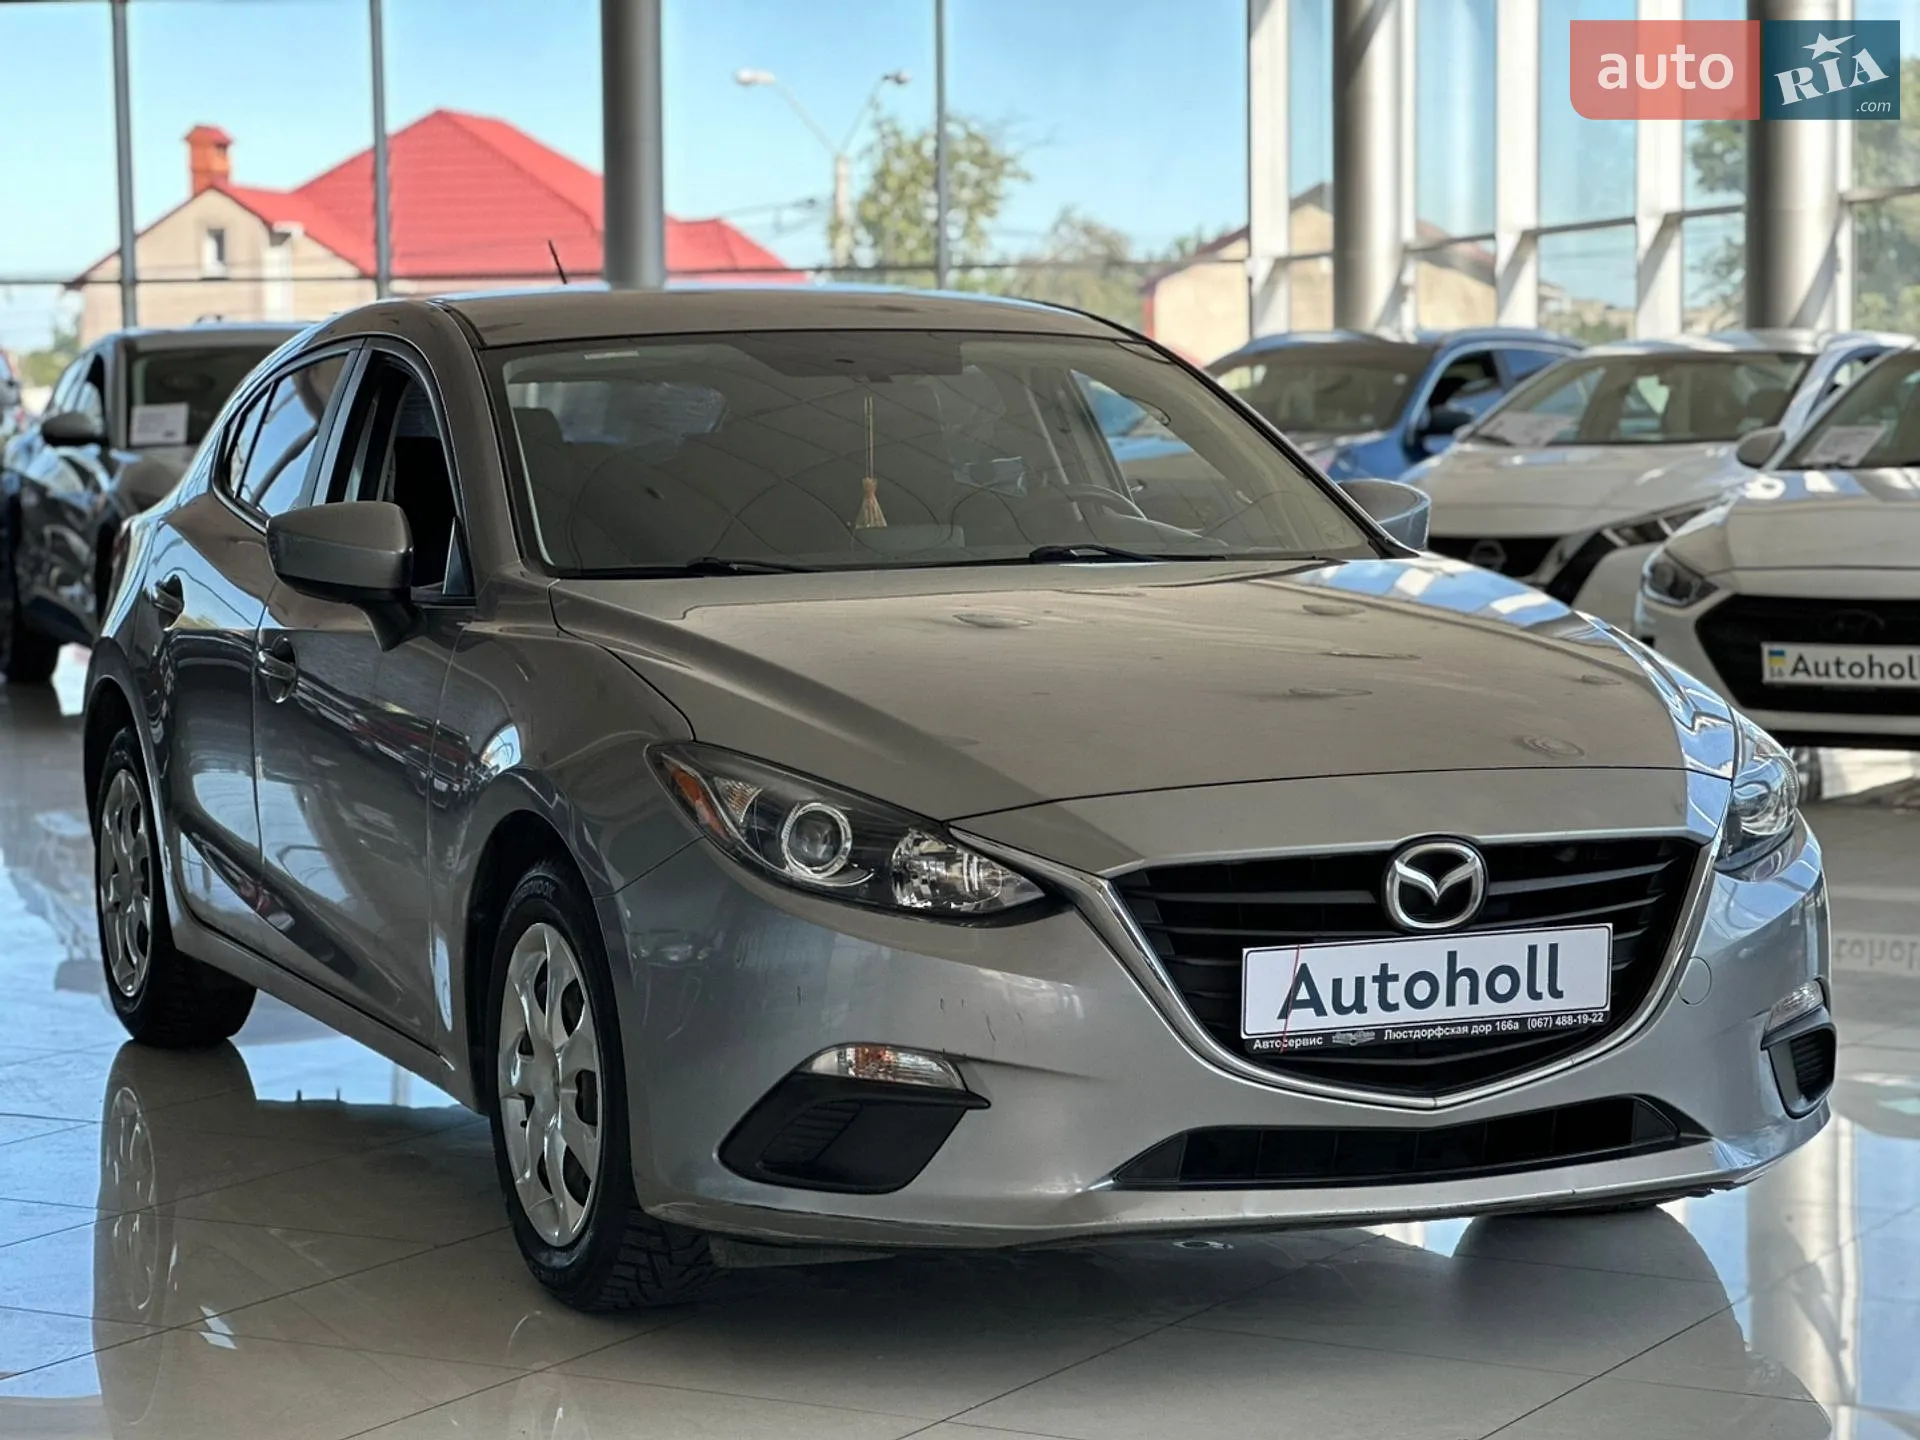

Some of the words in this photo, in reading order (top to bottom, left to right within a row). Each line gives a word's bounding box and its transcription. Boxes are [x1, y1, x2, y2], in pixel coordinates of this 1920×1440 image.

[1790, 653, 1920, 681] Autohol
[1276, 942, 1564, 1021] Autoholl
[1253, 1036, 1323, 1050] Автосервис
[1384, 1026, 1468, 1041] Люстдорфская
[1471, 1024, 1492, 1035] дор
[1527, 1017, 1553, 1030] (067)
[1555, 1013, 1604, 1026] 488-19-22
